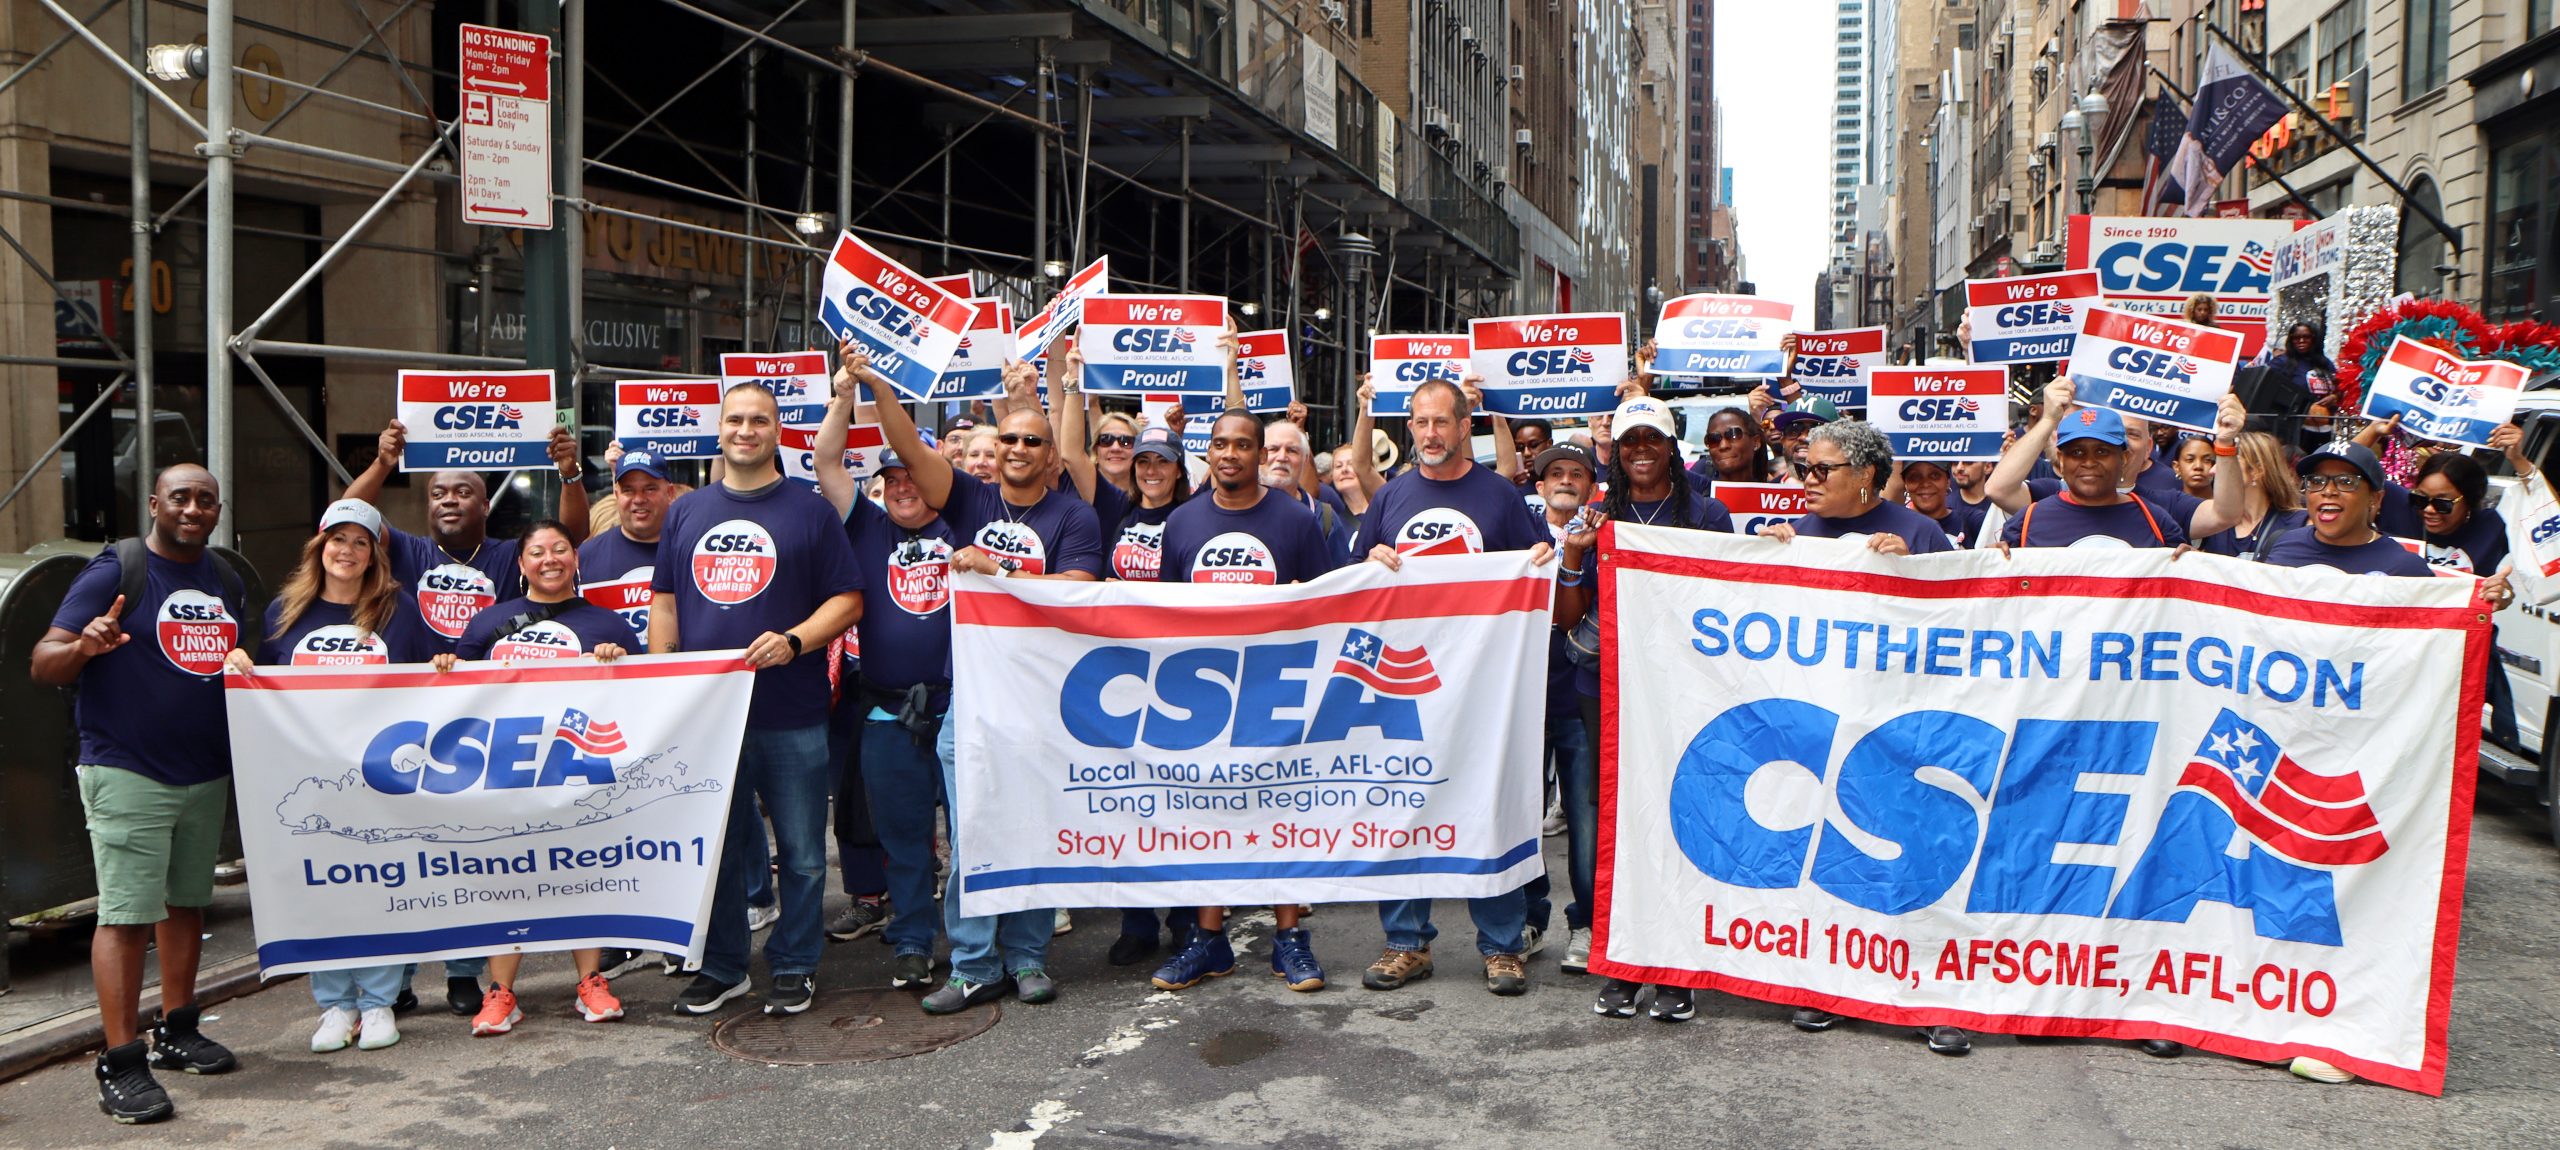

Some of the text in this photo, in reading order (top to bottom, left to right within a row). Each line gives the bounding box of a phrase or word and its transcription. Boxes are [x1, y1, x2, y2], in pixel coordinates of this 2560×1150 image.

[466, 31, 536, 53] NO STANDING
[466, 47, 531, 68] Monday Friday
[466, 60, 509, 76] 7am 2pm
[498, 97, 520, 109] Truck
[497, 108, 529, 122] Loading
[497, 120, 516, 131] Only
[466, 135, 541, 155] Saturday & Sunday
[467, 151, 510, 165] 7am 2pm
[468, 175, 510, 187] 2pm 7am
[468, 187, 502, 200] All Days
[2104, 226, 2178, 239] Since 1910
[2094, 240, 2274, 294] CSEA
[876, 267, 931, 309] We're
[2006, 282, 2058, 300] We're
[1128, 303, 1183, 321] We're
[1701, 301, 1753, 314] We're
[1996, 301, 2074, 328] CSEA
[2123, 301, 2165, 313] York's
[845, 287, 930, 346] CSEA
[1520, 325, 1579, 343] We're
[1683, 318, 1762, 339] CSEA
[2131, 322, 2191, 349] We're
[1112, 327, 1196, 353] CSEA
[1407, 342, 1452, 356] We're
[1801, 338, 1848, 352] We're
[2008, 339, 2069, 357] Proud!
[755, 360, 796, 374] We're
[1506, 347, 1594, 377] CSEA
[1686, 354, 1751, 369] Proud!
[1791, 356, 1860, 377] CSEA
[2107, 346, 2198, 384] CSEA
[2433, 359, 2481, 382] We're
[1122, 370, 1187, 388] Proud!
[1395, 360, 1463, 382] CSEA
[448, 380, 507, 398] We're
[1913, 376, 1967, 392] We're
[646, 388, 688, 402] We're
[1518, 392, 1586, 411] Proud!
[2106, 387, 2180, 417] Proud!
[1796, 397, 1818, 415] M
[1898, 397, 1980, 422] CSEA
[433, 403, 524, 430] CSEA
[636, 406, 701, 428] CSEA
[2400, 409, 2469, 437] Proud!
[647, 440, 698, 454] Proud!
[1907, 437, 1971, 453] Proud!
[446, 447, 516, 464] Proud!
[1760, 493, 1808, 510] We'r
[704, 533, 767, 553] CSEA
[982, 528, 1036, 554] CSEA
[1131, 544, 1162, 560] PROU
[1201, 546, 1266, 567] CSEA
[714, 556, 754, 567] PROUD
[703, 567, 761, 584] UNION
[906, 565, 940, 580] PROUD
[1211, 571, 1254, 582] PROUD
[426, 574, 485, 592] CSEA
[707, 582, 753, 593] MEMBER
[896, 574, 948, 592] UNION
[436, 594, 476, 605] PROUD
[900, 590, 945, 603] MEMBER
[168, 603, 226, 621] CSEA
[181, 624, 220, 635] PROUD
[506, 631, 572, 646] CSEA
[173, 635, 229, 652] UNION
[306, 636, 378, 653] CSEA
[514, 645, 558, 658] PROUD
[180, 652, 226, 663] MEMBER
[317, 655, 364, 666] PROUD
[1691, 607, 2366, 711] SOUTHERN REGION
[1059, 627, 1443, 751] CSEA
[361, 707, 628, 795] CSEA
[1068, 754, 1434, 785] Local 1000 AFSCME, AFL-CIO
[1087, 785, 1426, 818] Long Island Region One
[1669, 698, 2391, 947] CSEA
[1057, 820, 1457, 860] Stay Union Stay Strong
[303, 836, 704, 892] Long Island Region 1
[385, 876, 641, 914] Jarvis Brown, President
[1704, 904, 2338, 1018] Local 1000, AFSCME, AFL-CIO
